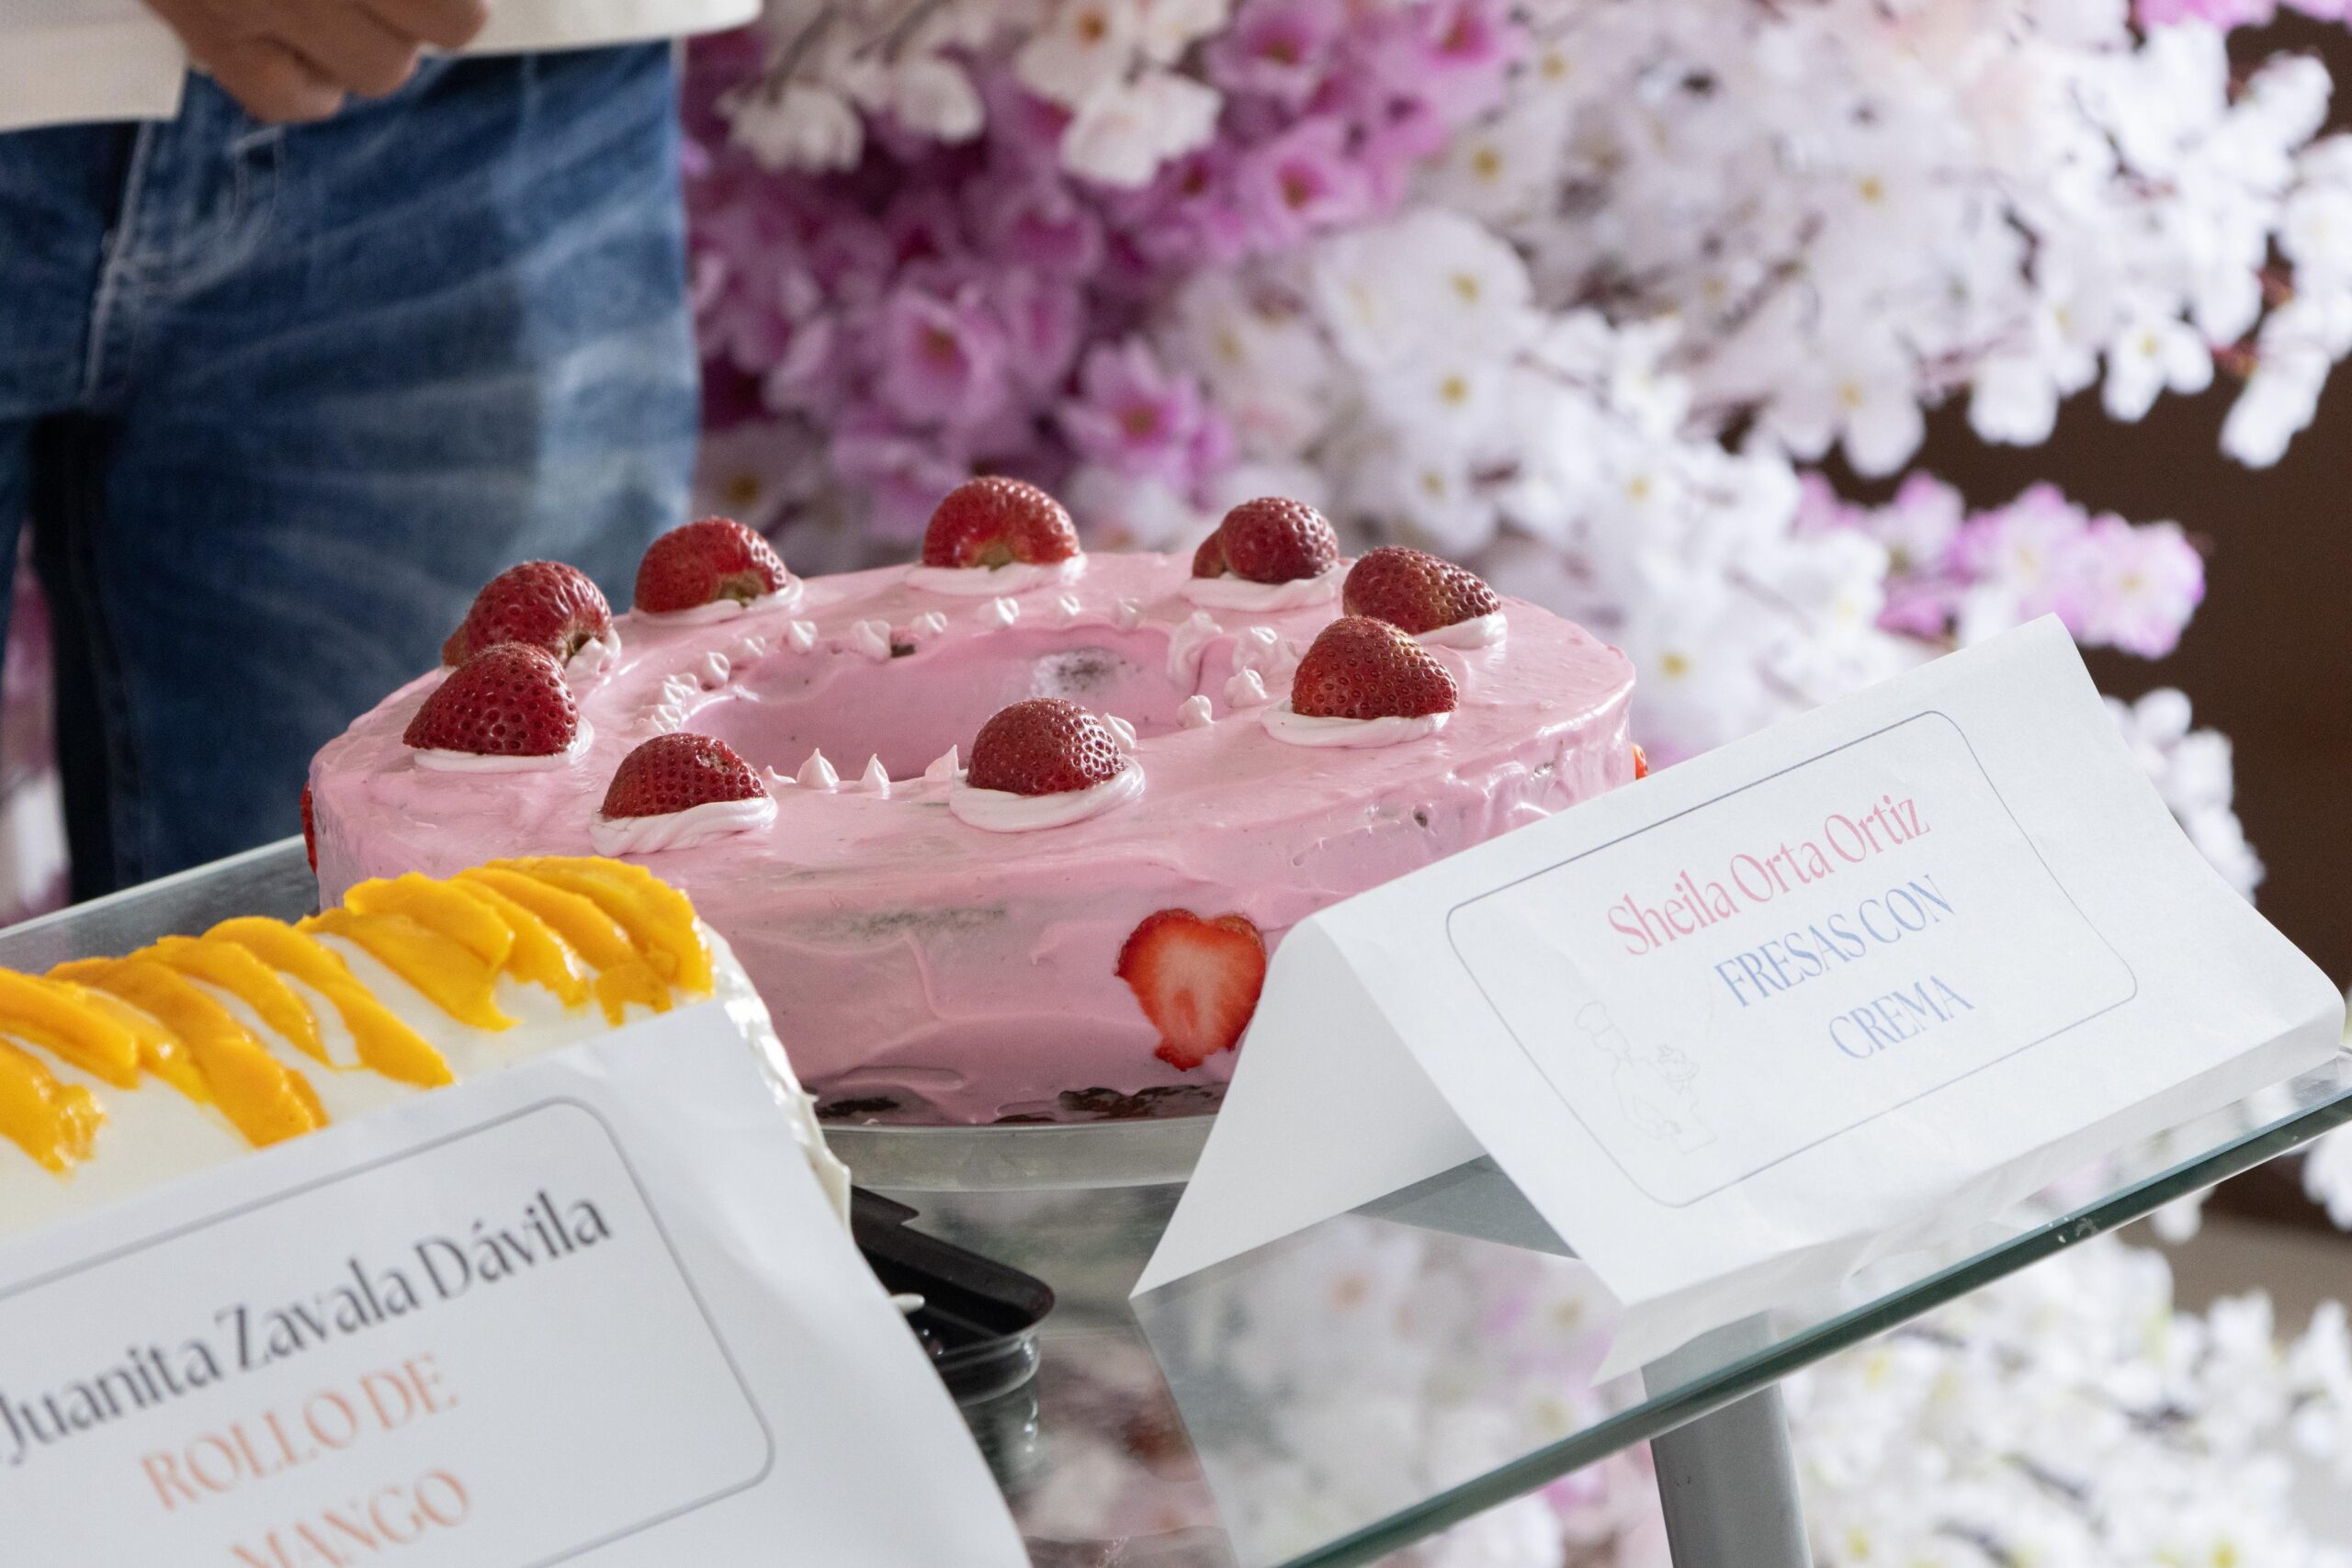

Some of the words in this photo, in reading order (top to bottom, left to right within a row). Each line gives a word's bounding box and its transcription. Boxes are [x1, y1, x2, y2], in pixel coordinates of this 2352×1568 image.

[1608, 870, 1740, 955] Sheila
[1730, 841, 1835, 903] Orta
[1824, 795, 1930, 863] Ortiz
[1714, 913, 1866, 1008] FRESAS
[1859, 874, 1954, 943] CON
[1828, 976, 1974, 1059] CREMA
[0, 1340, 223, 1466] Juanita
[215, 1257, 420, 1372] Zavala
[414, 1189, 612, 1300] Dávila
[140, 1390, 359, 1511] ROLLO
[358, 1353, 458, 1431] DE
